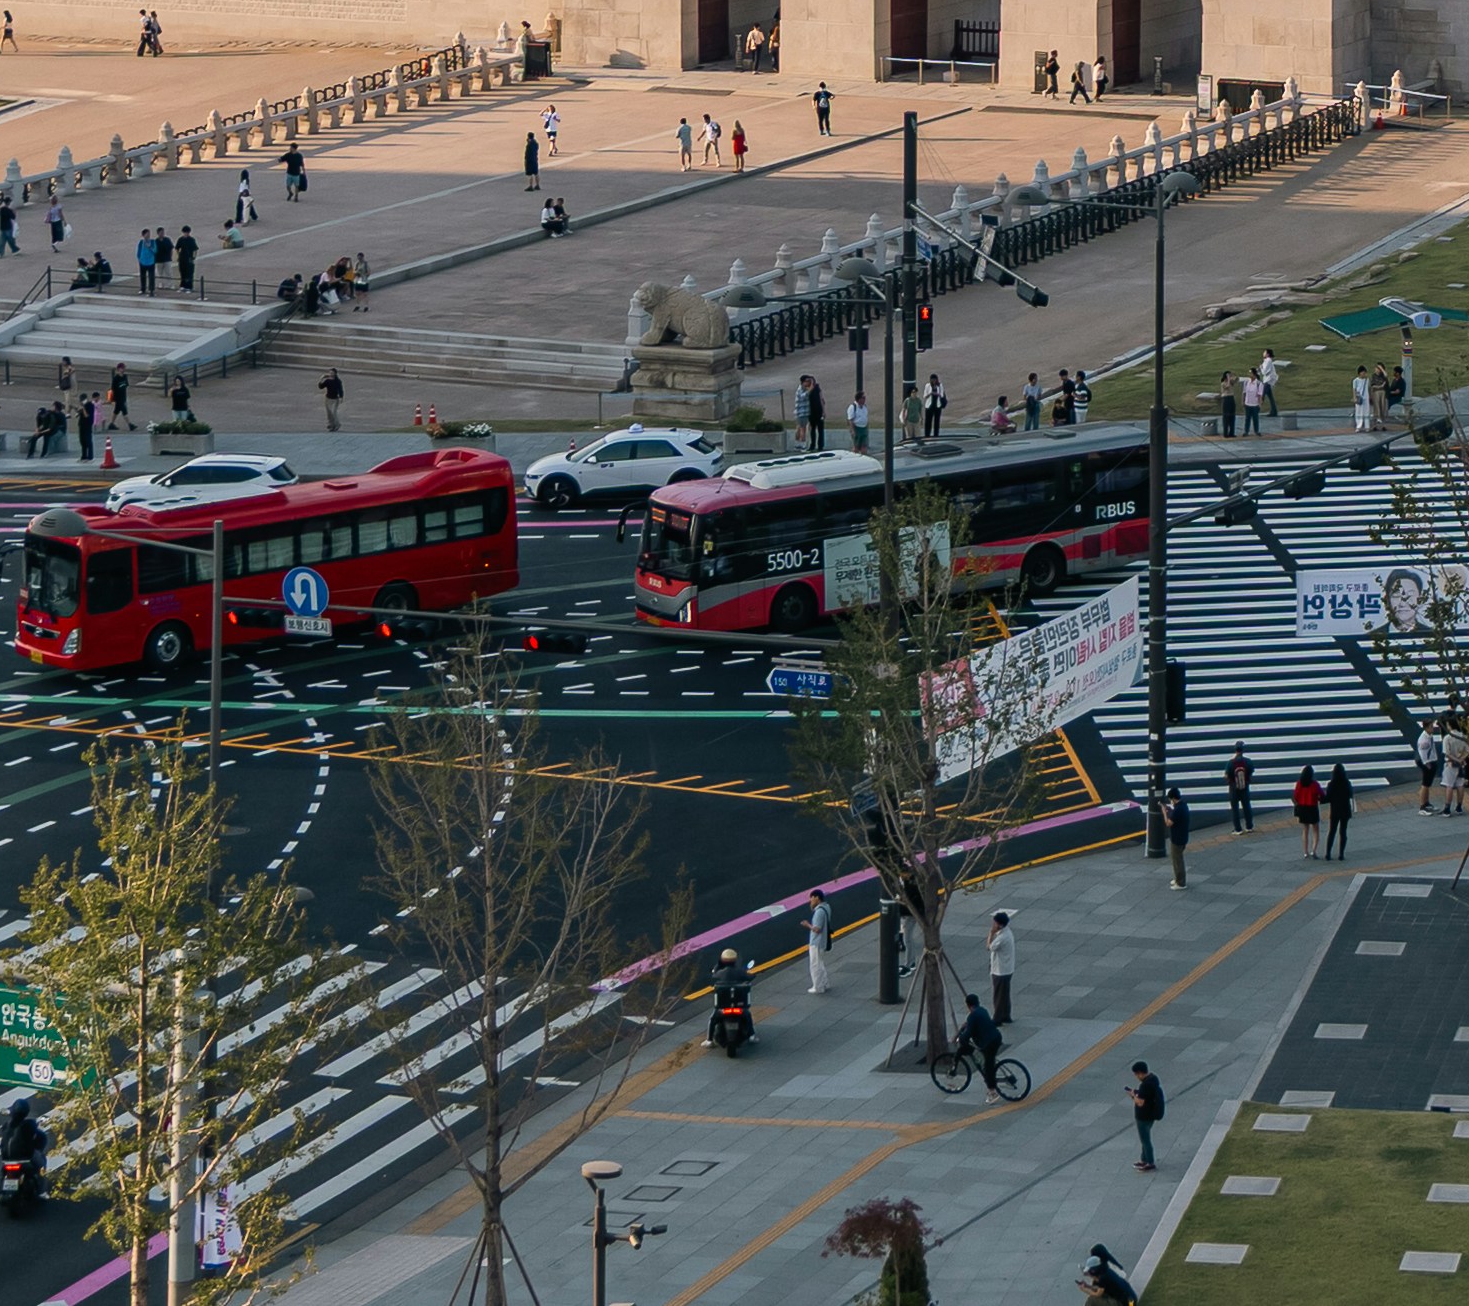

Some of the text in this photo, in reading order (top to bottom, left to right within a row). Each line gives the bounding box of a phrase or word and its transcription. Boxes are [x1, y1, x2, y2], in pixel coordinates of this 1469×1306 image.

[767, 548, 820, 572] 5500-2
[796, 674, 827, 686] 사직로
[1, 1002, 47, 1031] 안국동
[34, 1064, 49, 1080] 50
